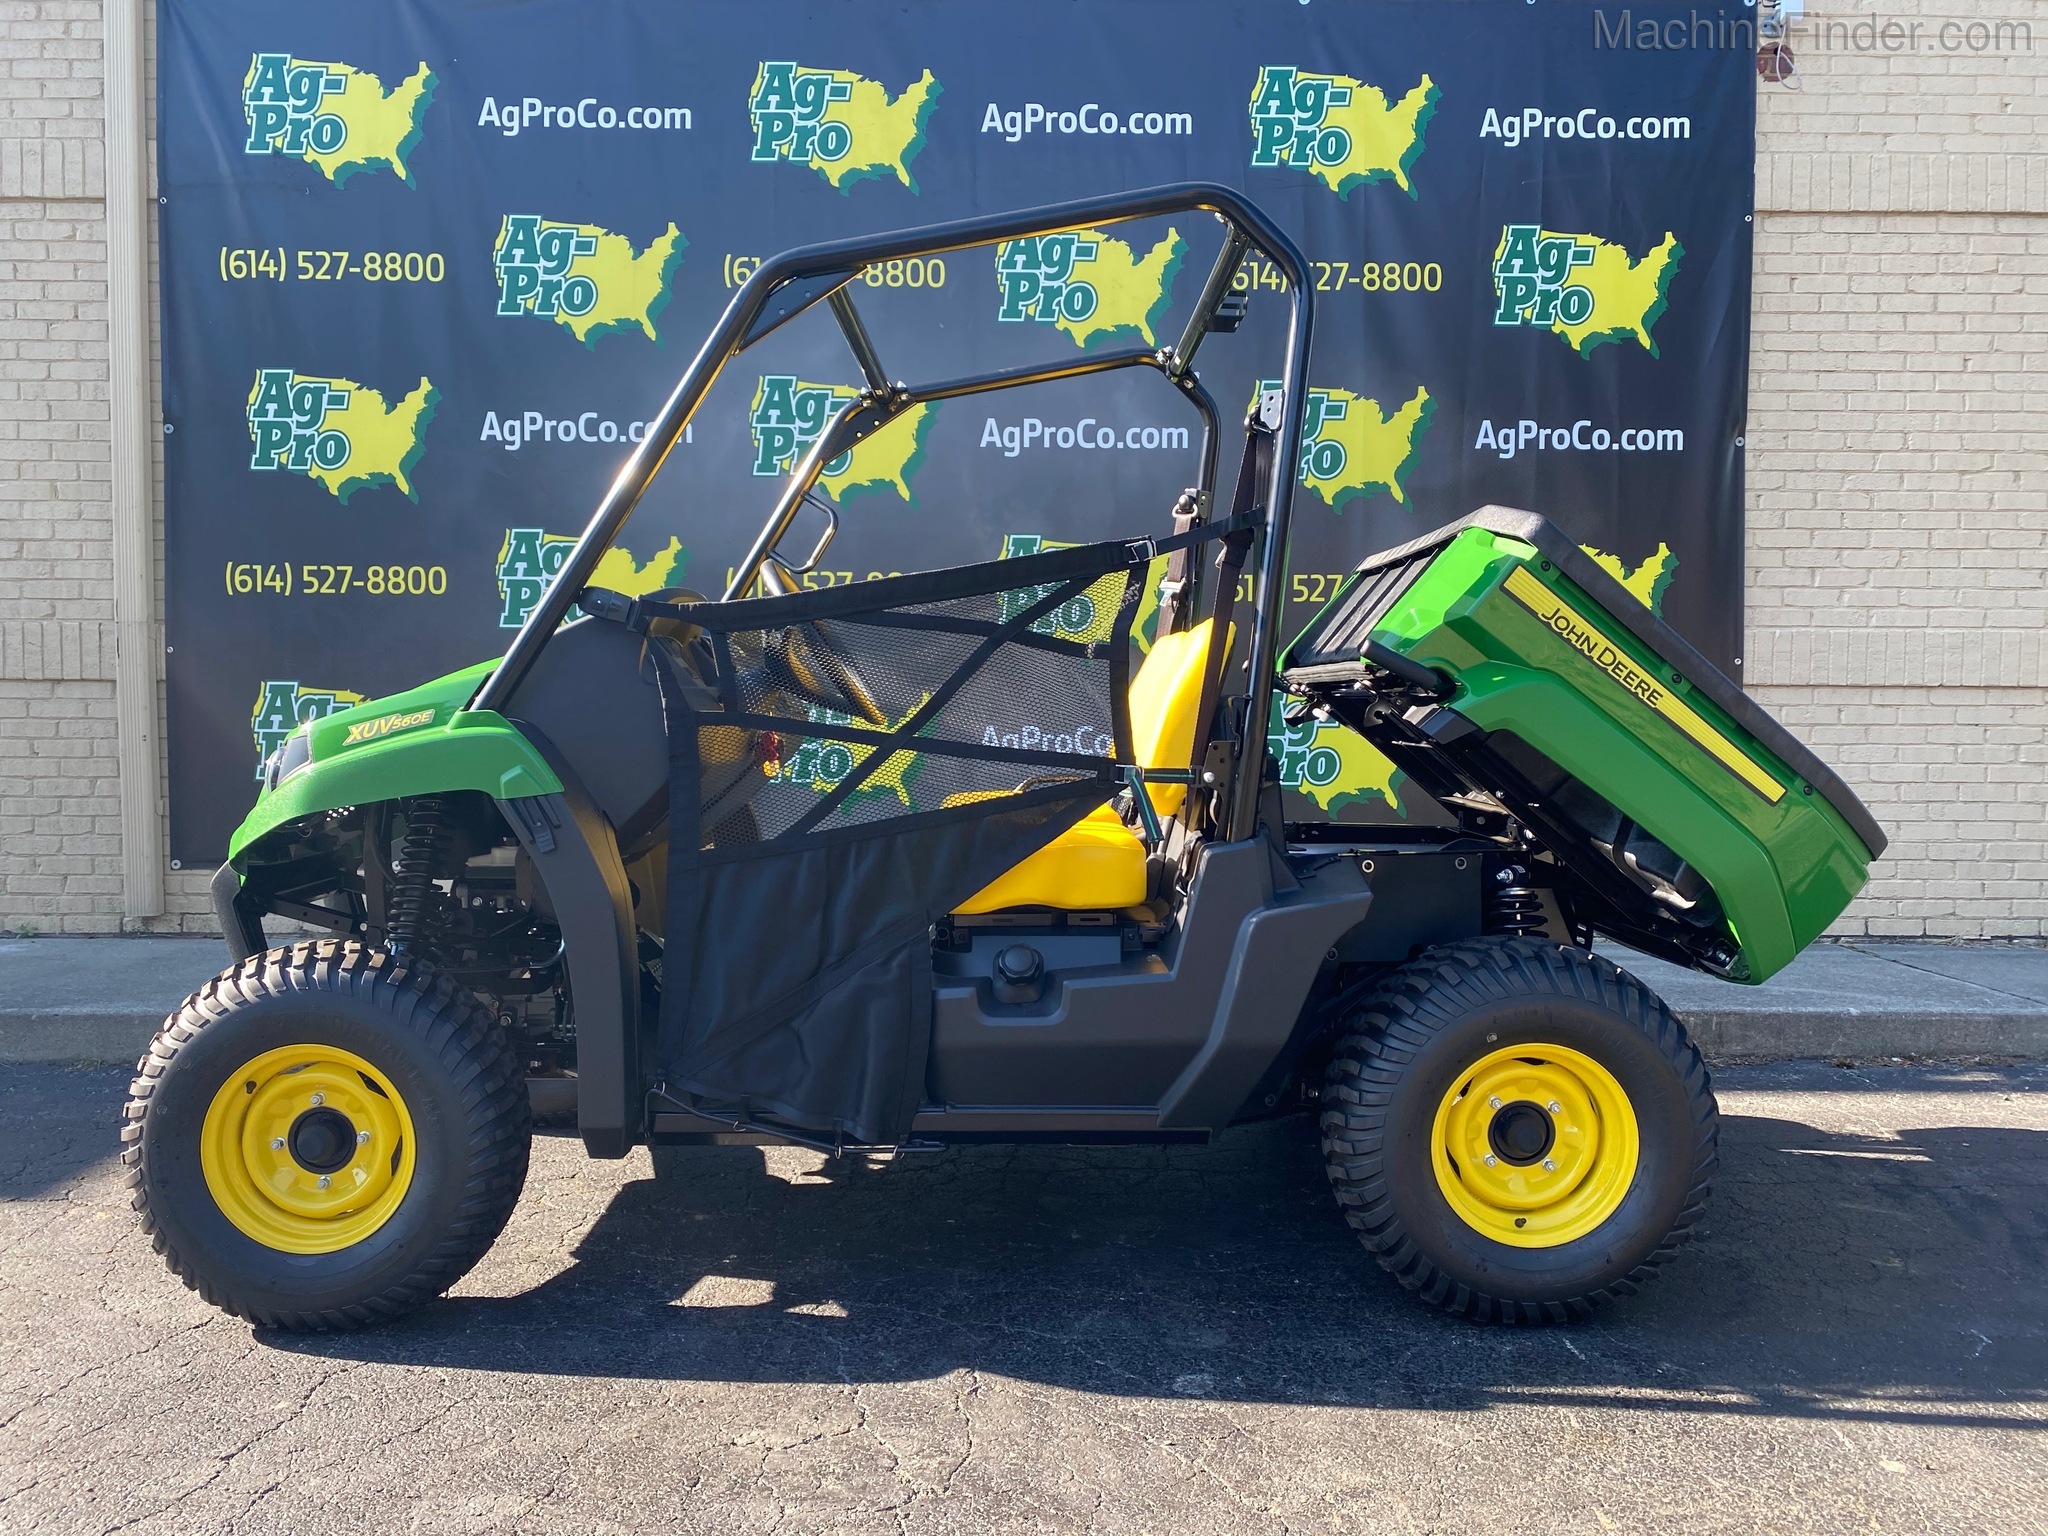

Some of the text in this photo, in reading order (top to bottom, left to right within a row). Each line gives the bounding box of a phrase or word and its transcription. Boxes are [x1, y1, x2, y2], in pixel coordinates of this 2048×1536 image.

[245, 53, 346, 115] Ag-
[751, 62, 852, 124] Ag-
[1252, 66, 1353, 128] Ag-
[245, 103, 345, 153] Pro
[478, 97, 691, 136] AgProCo.com
[751, 112, 851, 162] Pro
[981, 103, 1192, 142] AgProCo.com
[1252, 116, 1352, 166] Pro
[1480, 107, 1690, 146] AgProCo.com
[220, 247, 445, 282] (614) 527-8800
[496, 215, 597, 277] Ag-
[1494, 225, 1595, 287] Ag-
[496, 265, 596, 315] Pro
[855, 258, 946, 288] -8800
[998, 271, 1098, 322] Pro
[1309, 261, 1443, 292] 27-8800
[1494, 275, 1594, 325] Pro
[249, 370, 350, 432] Ag-
[249, 420, 349, 470] Pro
[980, 418, 1189, 457] AgProCo.com
[1475, 419, 1684, 459] AgProCo.com
[225, 561, 447, 596] (614) 527-8800
[1540, 607, 1664, 707] JOHN DEERE
[345, 710, 433, 744] XUV560E
